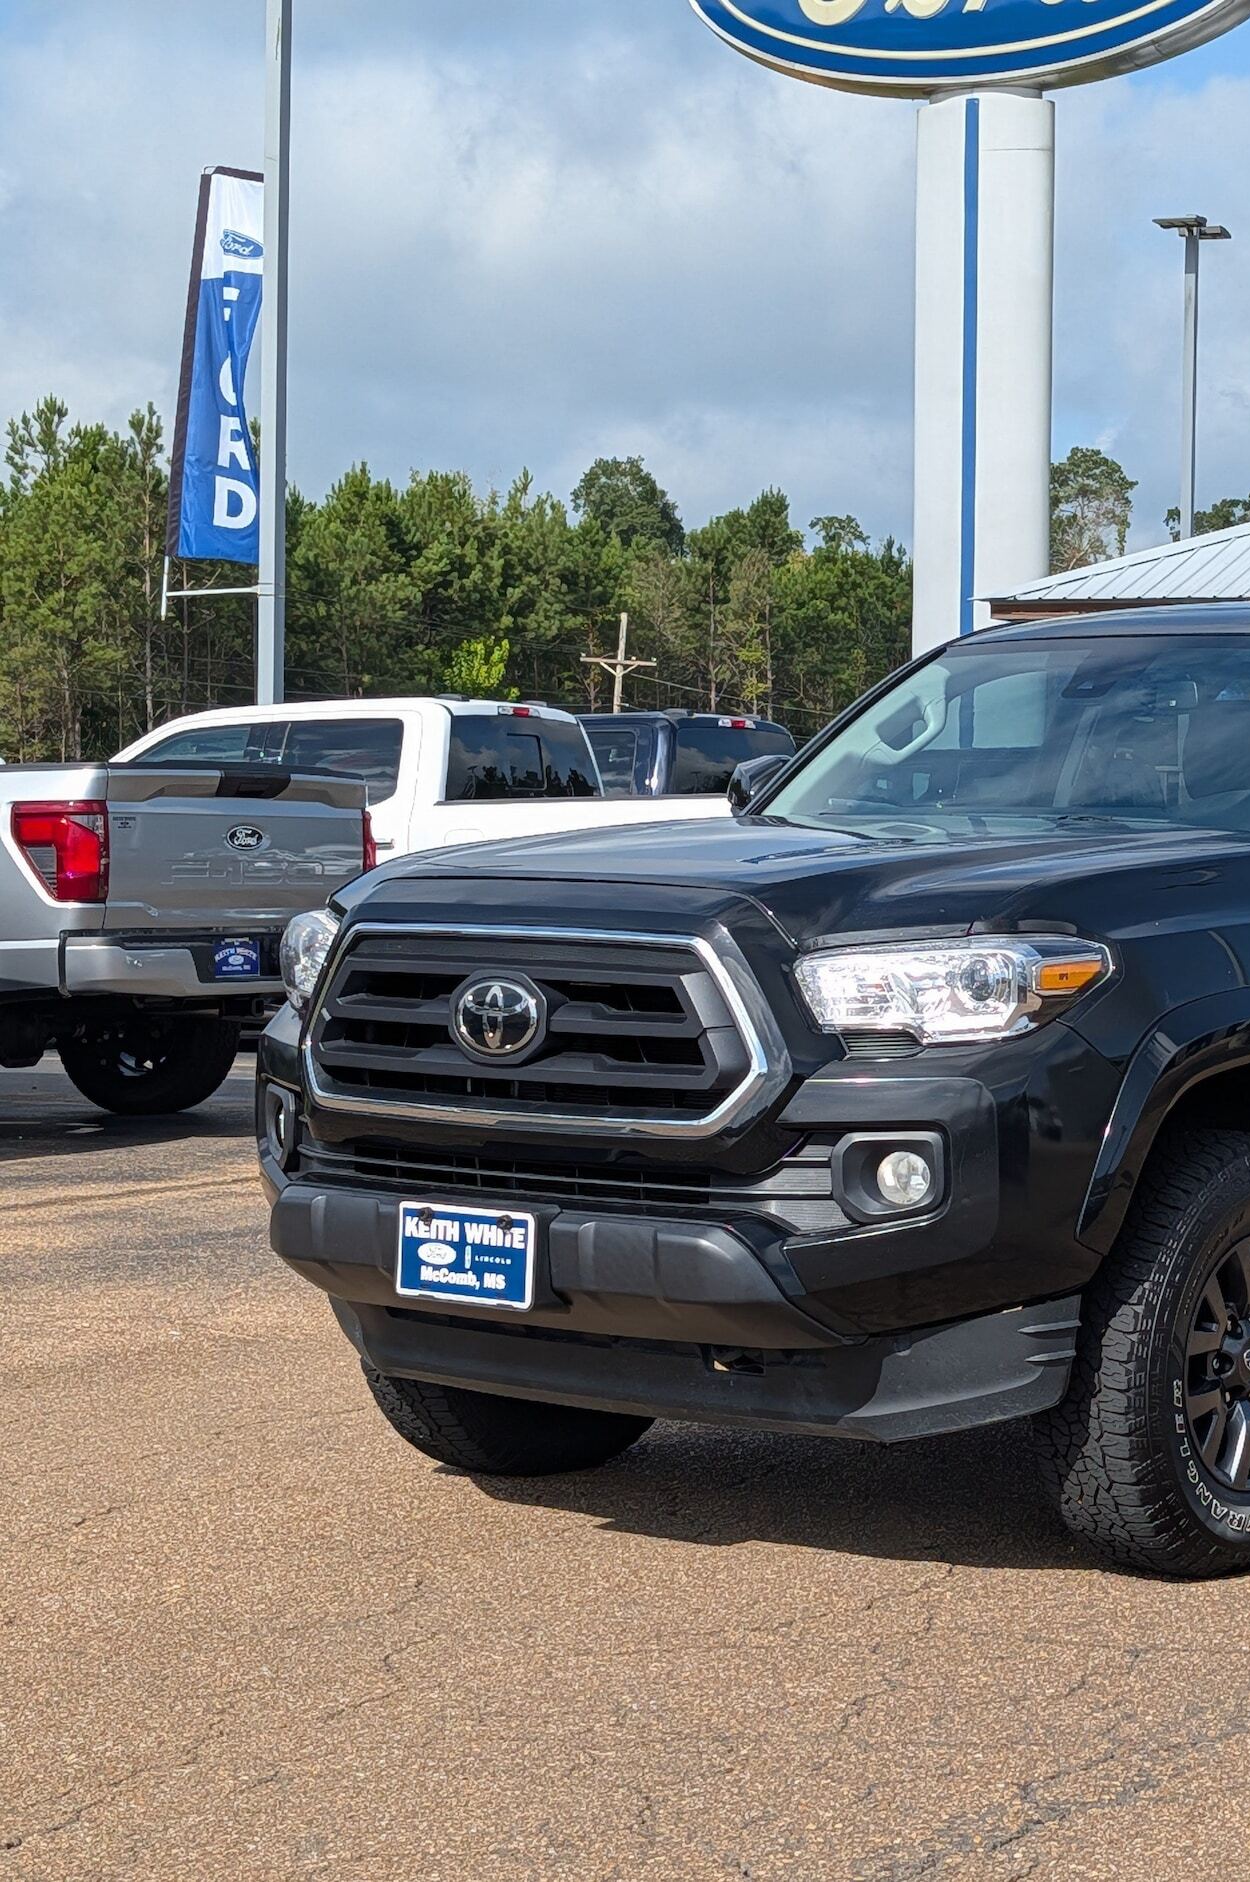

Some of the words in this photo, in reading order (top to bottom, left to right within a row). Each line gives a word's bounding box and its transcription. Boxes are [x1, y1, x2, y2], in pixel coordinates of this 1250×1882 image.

[233, 828, 259, 846] Ford
[404, 1216, 460, 1243] KEITH
[464, 1222, 526, 1249] WHITE
[420, 1265, 480, 1290] McComb,
[483, 1272, 506, 1290] MS
